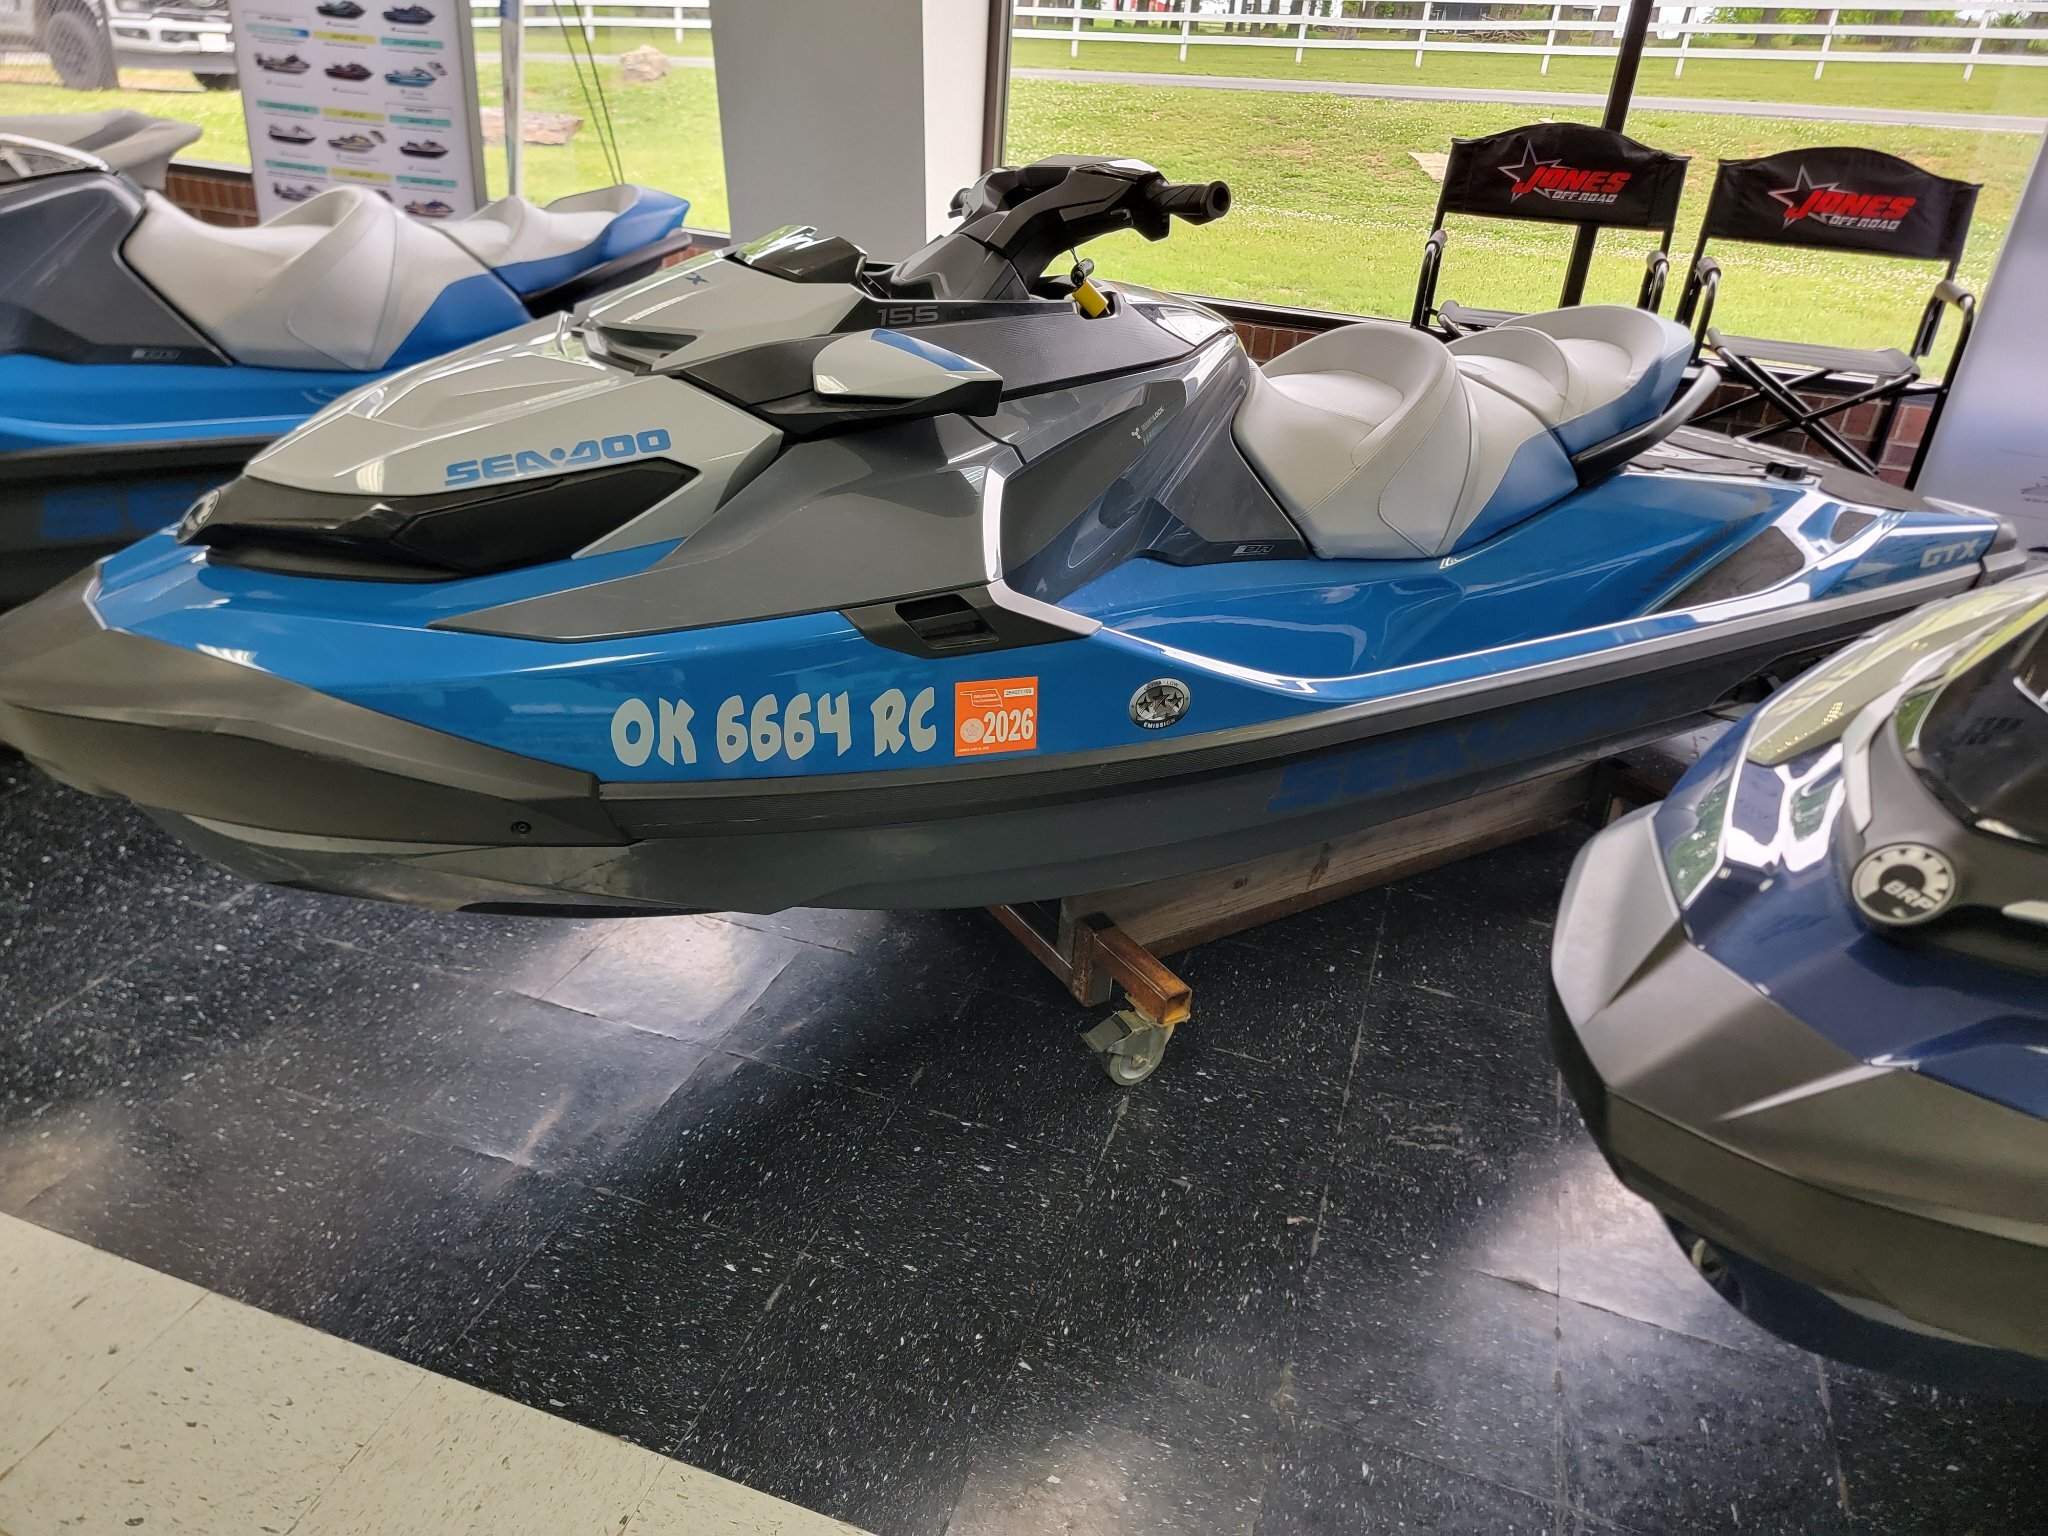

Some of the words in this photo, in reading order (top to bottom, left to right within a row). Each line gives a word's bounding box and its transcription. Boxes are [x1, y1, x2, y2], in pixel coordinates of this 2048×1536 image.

[1511, 166, 1632, 194] JONES
[1552, 191, 1580, 200] OFF
[1579, 192, 1618, 203] ROAD
[1783, 189, 1917, 219] JONES
[1829, 216, 1857, 227] OFF
[1856, 217, 1901, 230] ROAD
[877, 305, 939, 326] 155
[1920, 538, 1979, 568] GTX
[611, 697, 697, 767] OK
[716, 691, 852, 764] 6664
[870, 686, 937, 757] RC
[982, 707, 1034, 744] 2026
[1143, 718, 1176, 729] EMISSION
[1882, 880, 1935, 909] BRP
